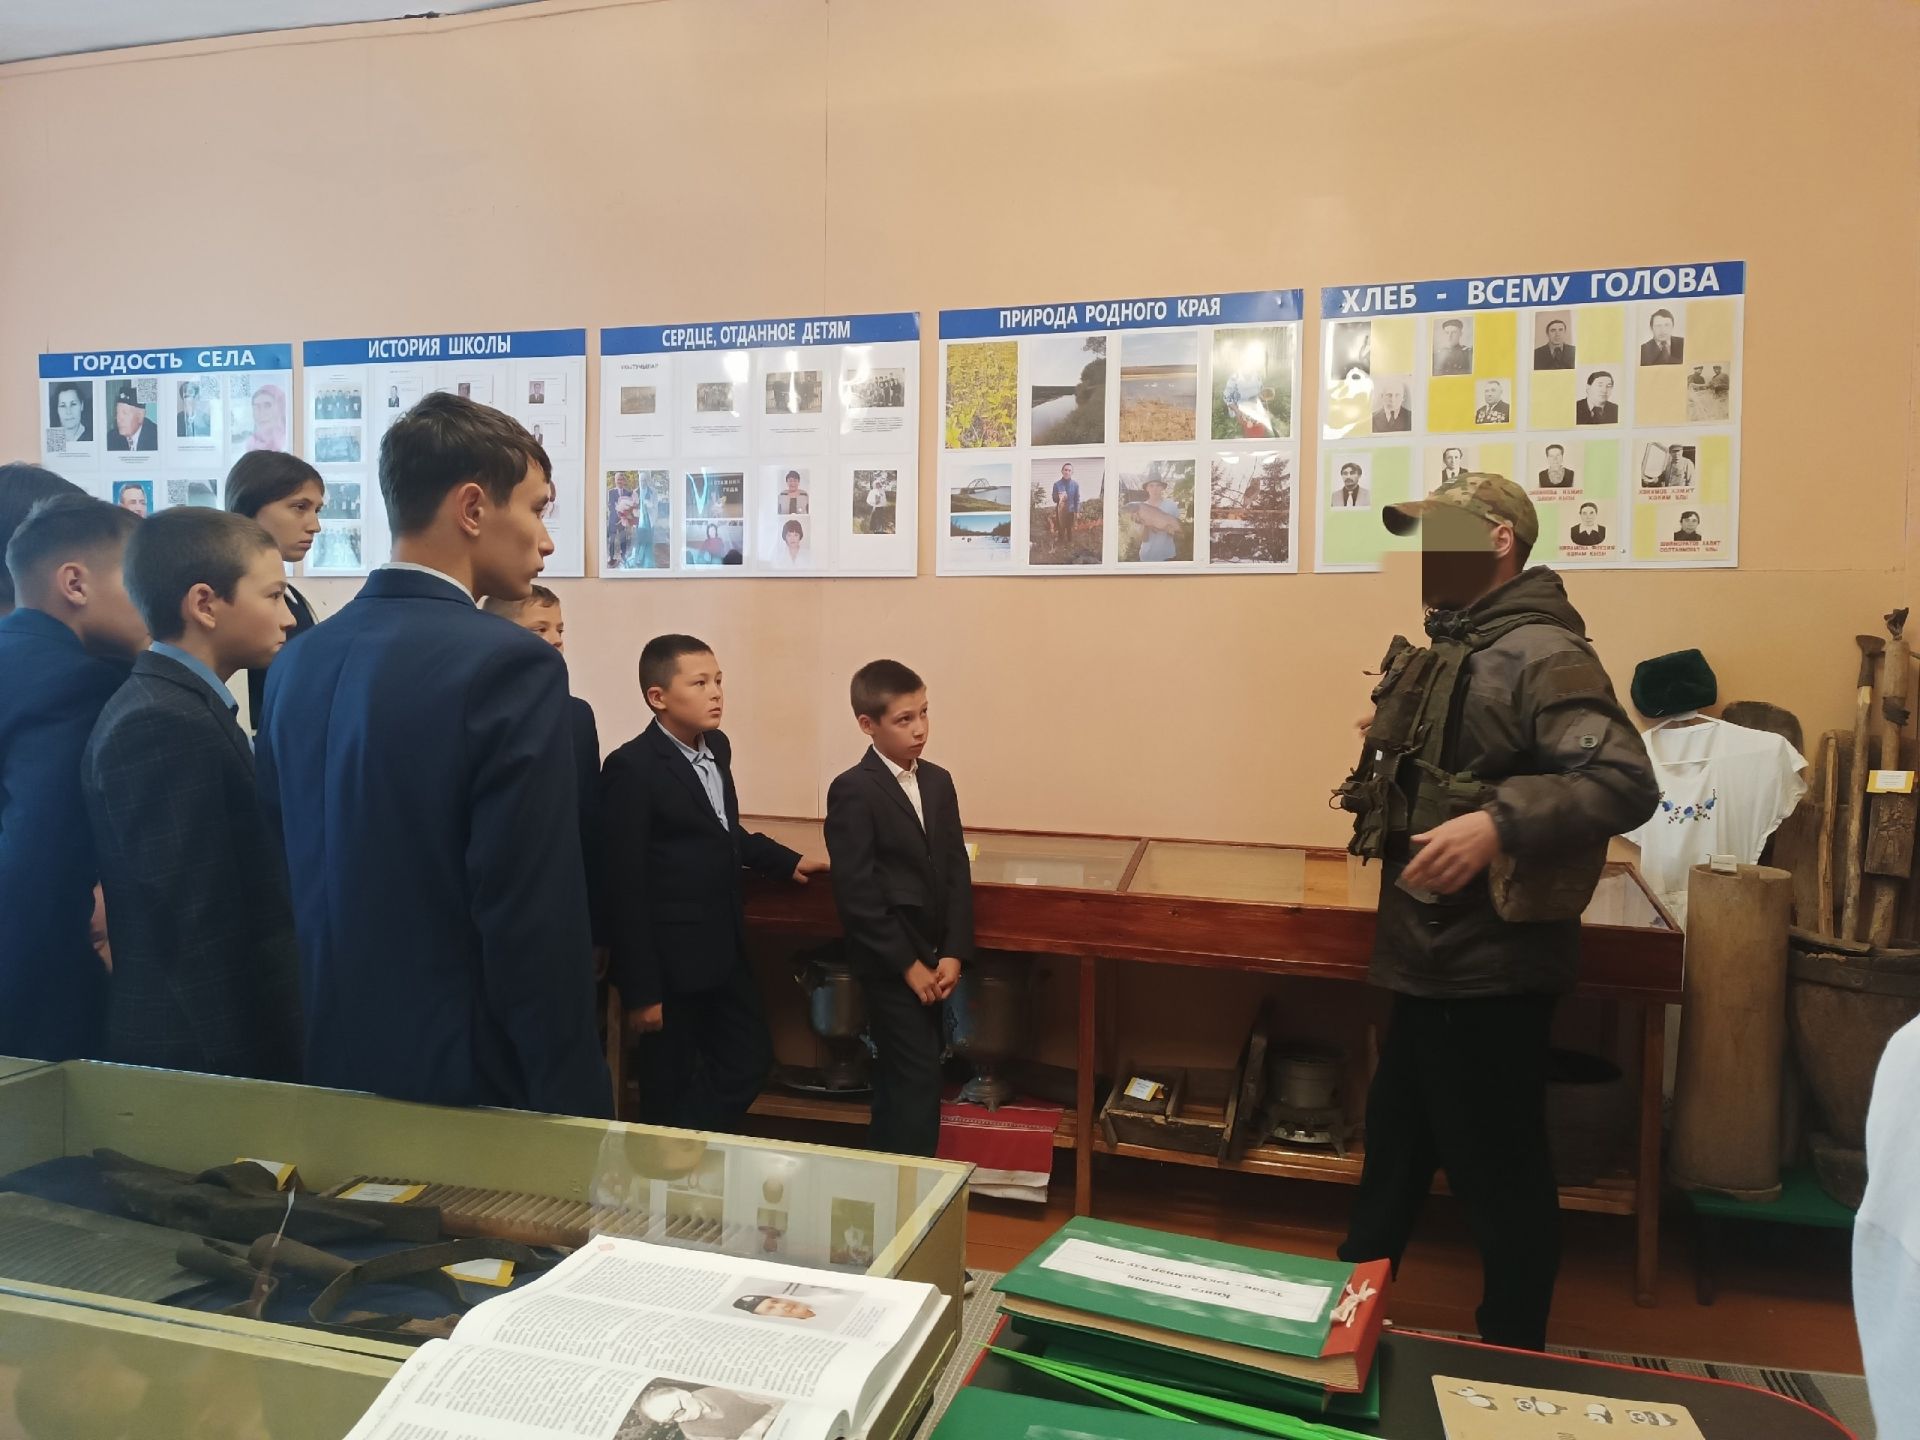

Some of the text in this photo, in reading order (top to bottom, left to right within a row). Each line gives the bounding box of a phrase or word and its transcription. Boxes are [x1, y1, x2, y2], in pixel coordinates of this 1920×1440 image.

[1342, 285, 1417, 313] ХЛЕБ
[1468, 276, 1570, 305] ВСЕМУ
[1591, 266, 1720, 299] ГОЛОВА
[1000, 297, 1221, 330] ПРИРОДА РОДНОГО КРАЯ
[368, 335, 511, 358] ИСТОРИЯ ШКОЛЫ
[662, 320, 851, 350] СЕРДЦЕ, ОТДАННОЕ ДЕТЯМ
[73, 350, 256, 374] ГОРДОСТЬ СЕЛА
